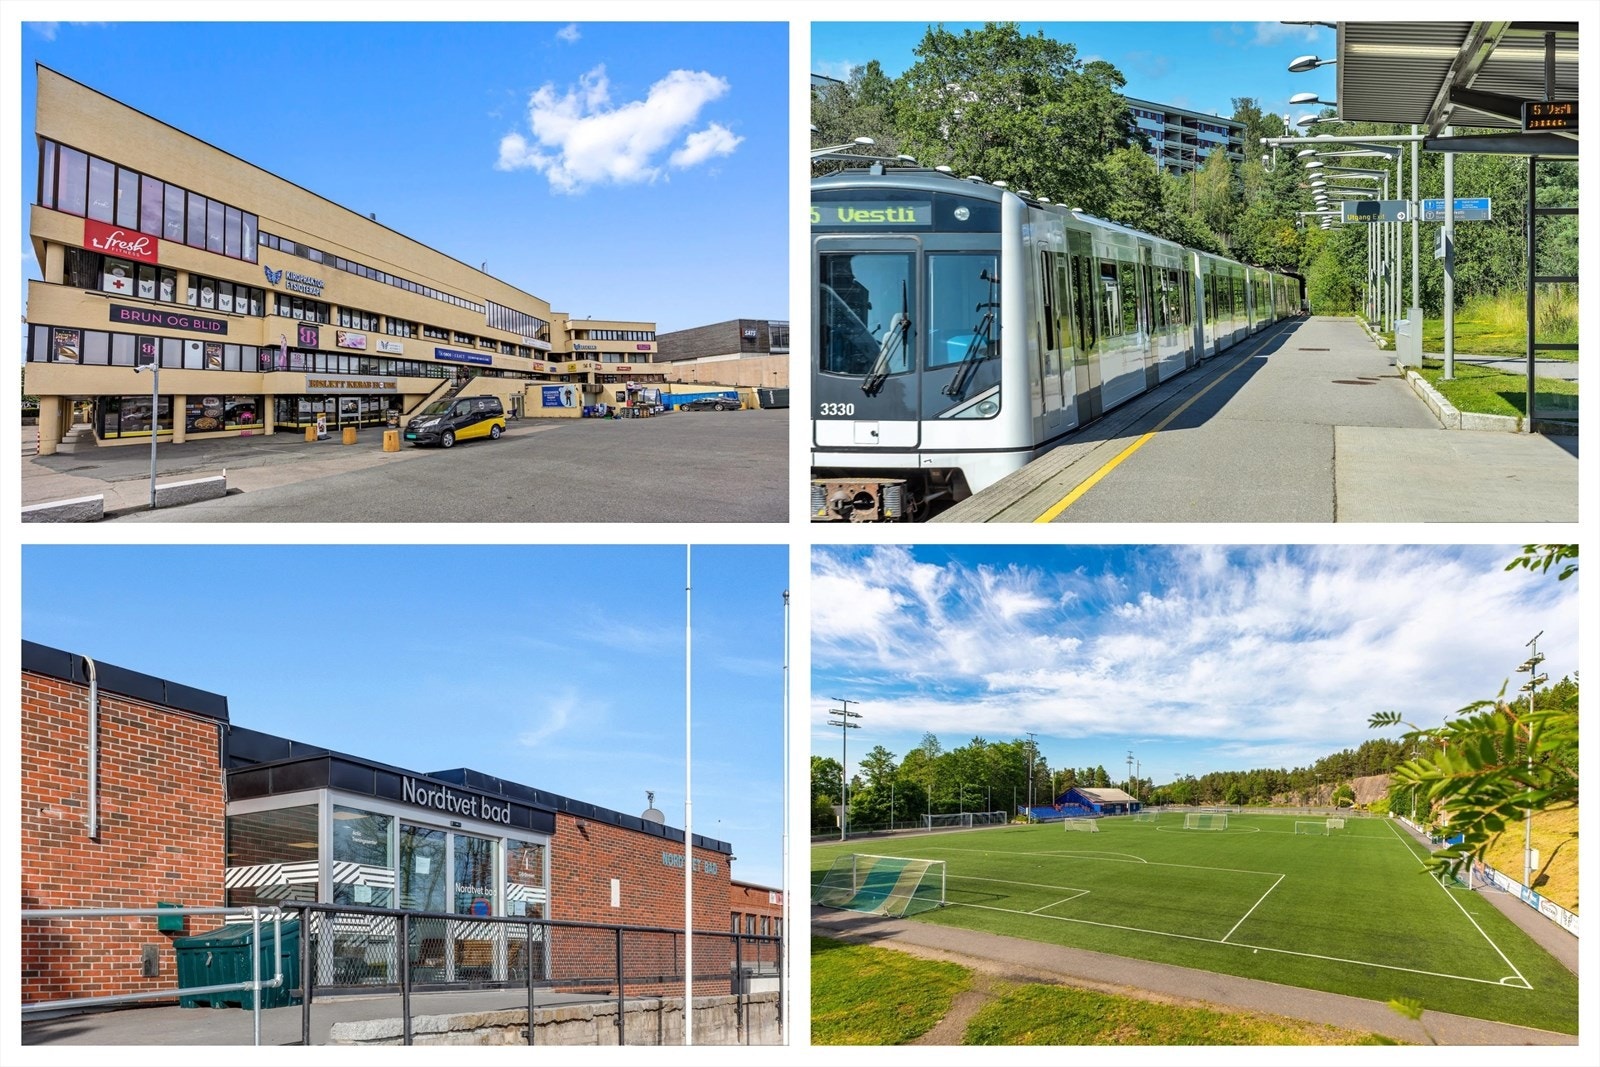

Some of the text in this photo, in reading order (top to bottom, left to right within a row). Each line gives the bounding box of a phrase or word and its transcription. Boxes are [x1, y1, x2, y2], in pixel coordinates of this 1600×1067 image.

[837, 206, 916, 223] Vestli
[104, 230, 152, 255] fresh
[111, 247, 140, 257] FITNESS
[286, 271, 324, 288] KIROPRAKTOR
[120, 309, 221, 331] BRUN OG BLID
[309, 379, 345, 388] BISLETT
[346, 381, 371, 389] KEBAB
[820, 402, 855, 416] 3330
[402, 776, 511, 824] Nordtvet bad
[704, 861, 718, 875] BAD
[455, 882, 497, 897] Nordtvet bad
